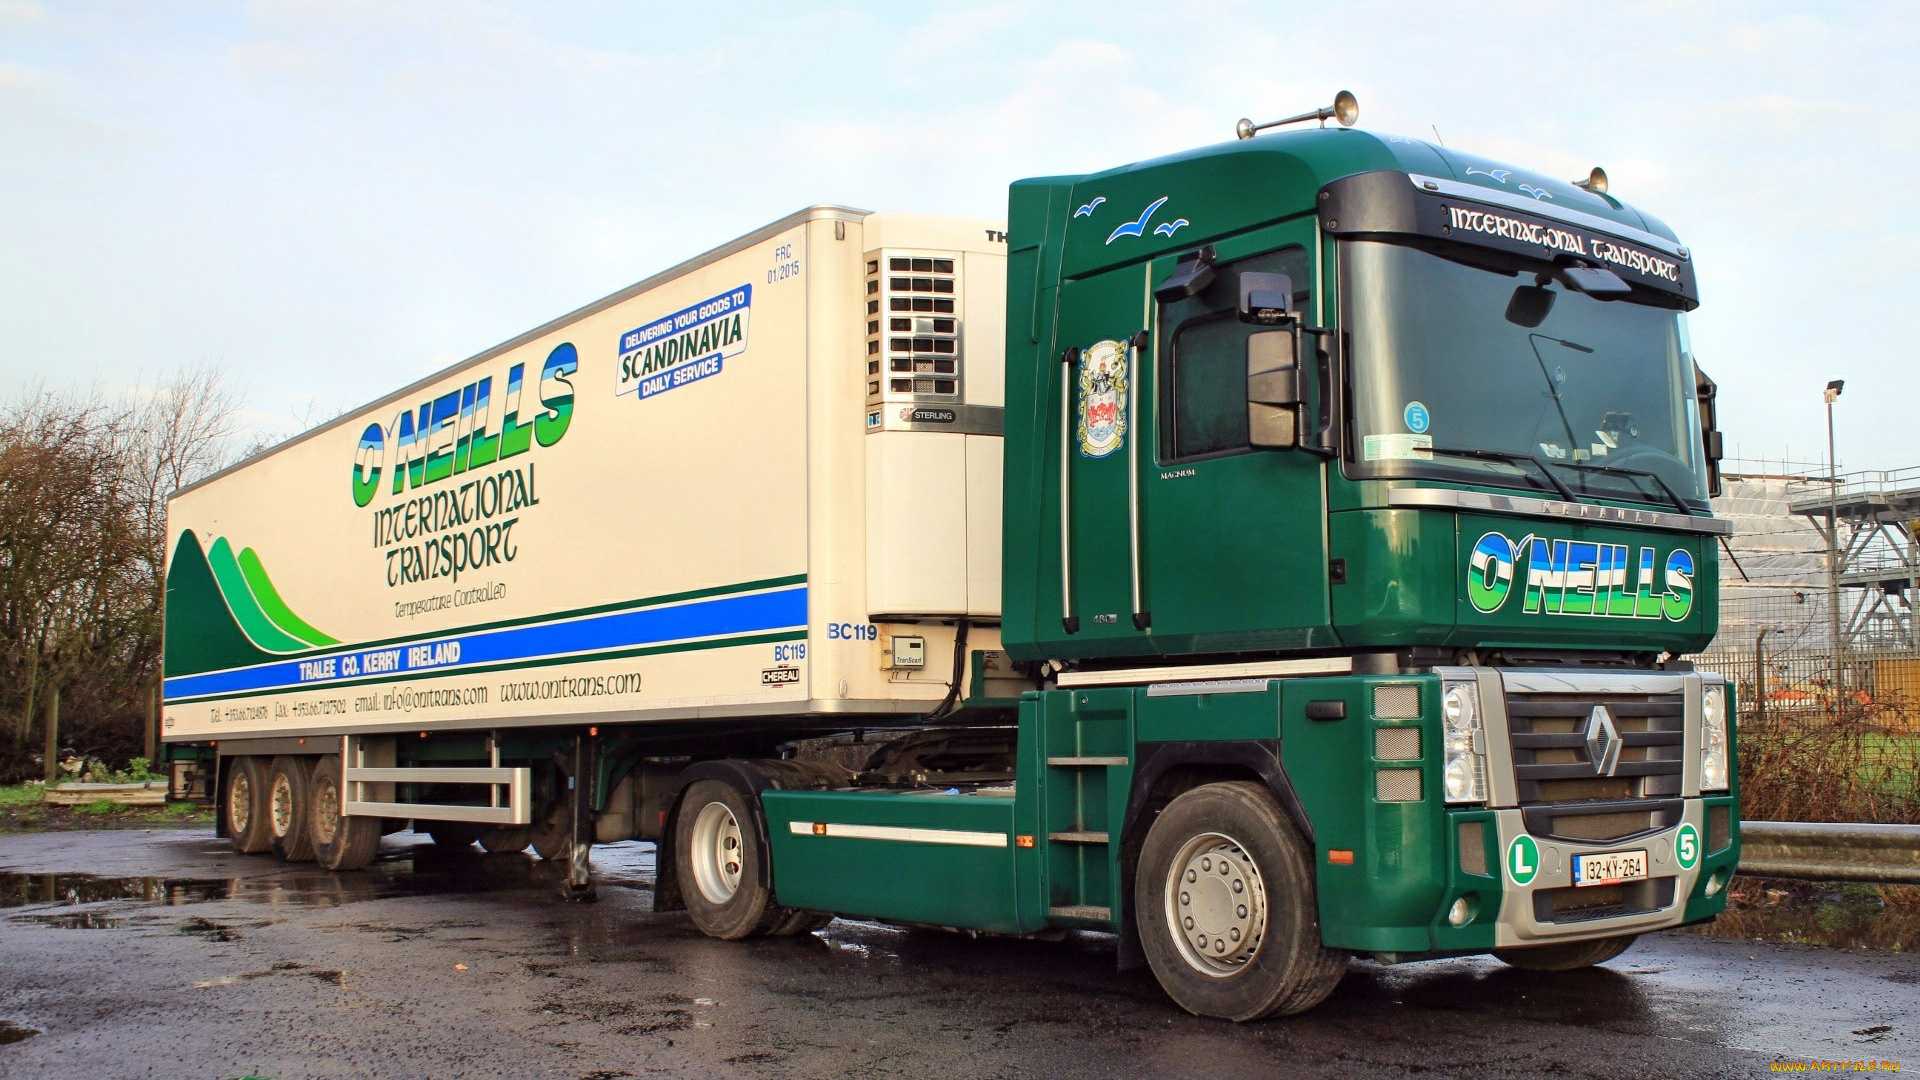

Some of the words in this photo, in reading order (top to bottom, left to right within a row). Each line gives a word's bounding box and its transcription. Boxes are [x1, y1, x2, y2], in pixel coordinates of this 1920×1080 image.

[776, 244, 791, 262] FRC
[1450, 207, 1586, 256] INTERNATIONAL
[1591, 239, 1677, 281] TRANSPORT
[767, 260, 799, 284] 01/2015
[625, 320, 672, 349] DELIVERING
[674, 309, 698, 329] YOUR
[699, 296, 731, 320] GOODS
[732, 290, 745, 307] TO
[621, 313, 743, 384] SCANDINAVIA
[642, 373, 671, 397] DAILY
[673, 356, 719, 386] SERVICE
[351, 341, 579, 508] O'NEILLS
[915, 411, 953, 420] STERLING
[1412, 412, 1424, 429] 5
[1160, 469, 1195, 479] MAGNUM
[373, 462, 540, 549] INTERNATIONAL
[1542, 501, 1660, 524] RENAULT
[386, 516, 519, 588] TRANSPORT
[1467, 531, 1694, 622] O'NEILLS
[394, 594, 452, 620] Temperature
[454, 581, 507, 608] Controlled
[827, 623, 878, 641] BC119
[299, 661, 336, 681] TRALEE
[342, 656, 360, 676] CO.
[363, 651, 400, 674] KERRY
[408, 641, 461, 669] IRELAND
[774, 643, 806, 661] BC119
[896, 656, 922, 664] TranScan
[762, 670, 799, 683] CHEREAU
[355, 692, 381, 712] email:
[383, 685, 488, 713] info@onitrans.com
[500, 672, 642, 703] www.onitrans.com
[1515, 844, 1533, 874] L
[1681, 832, 1695, 860] 5
[1586, 858, 1641, 879] 132-KY-264
